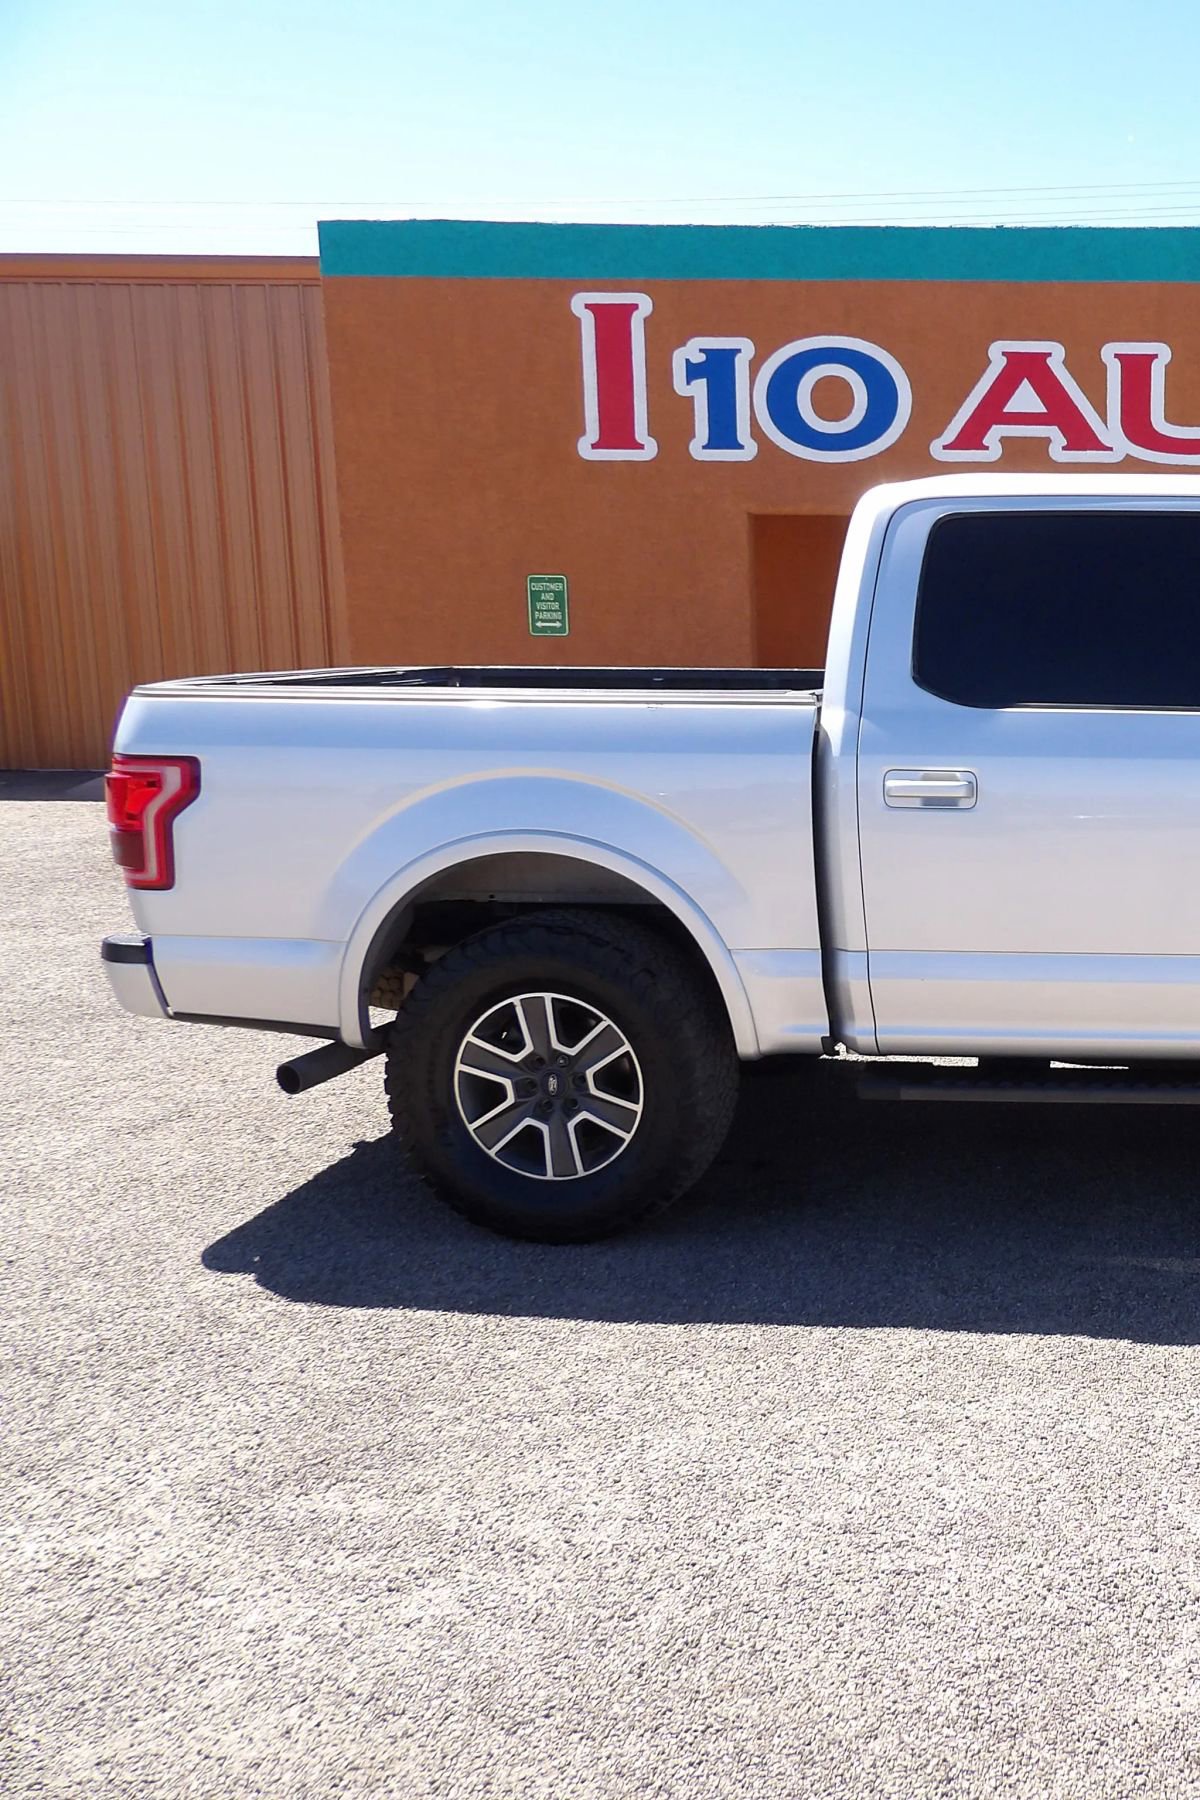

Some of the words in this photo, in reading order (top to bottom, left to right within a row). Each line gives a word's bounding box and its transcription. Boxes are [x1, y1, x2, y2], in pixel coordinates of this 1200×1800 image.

[531, 583, 563, 591] CUSTOMER
[536, 602, 560, 610] VISITOR
[535, 611, 562, 620] PARKING
